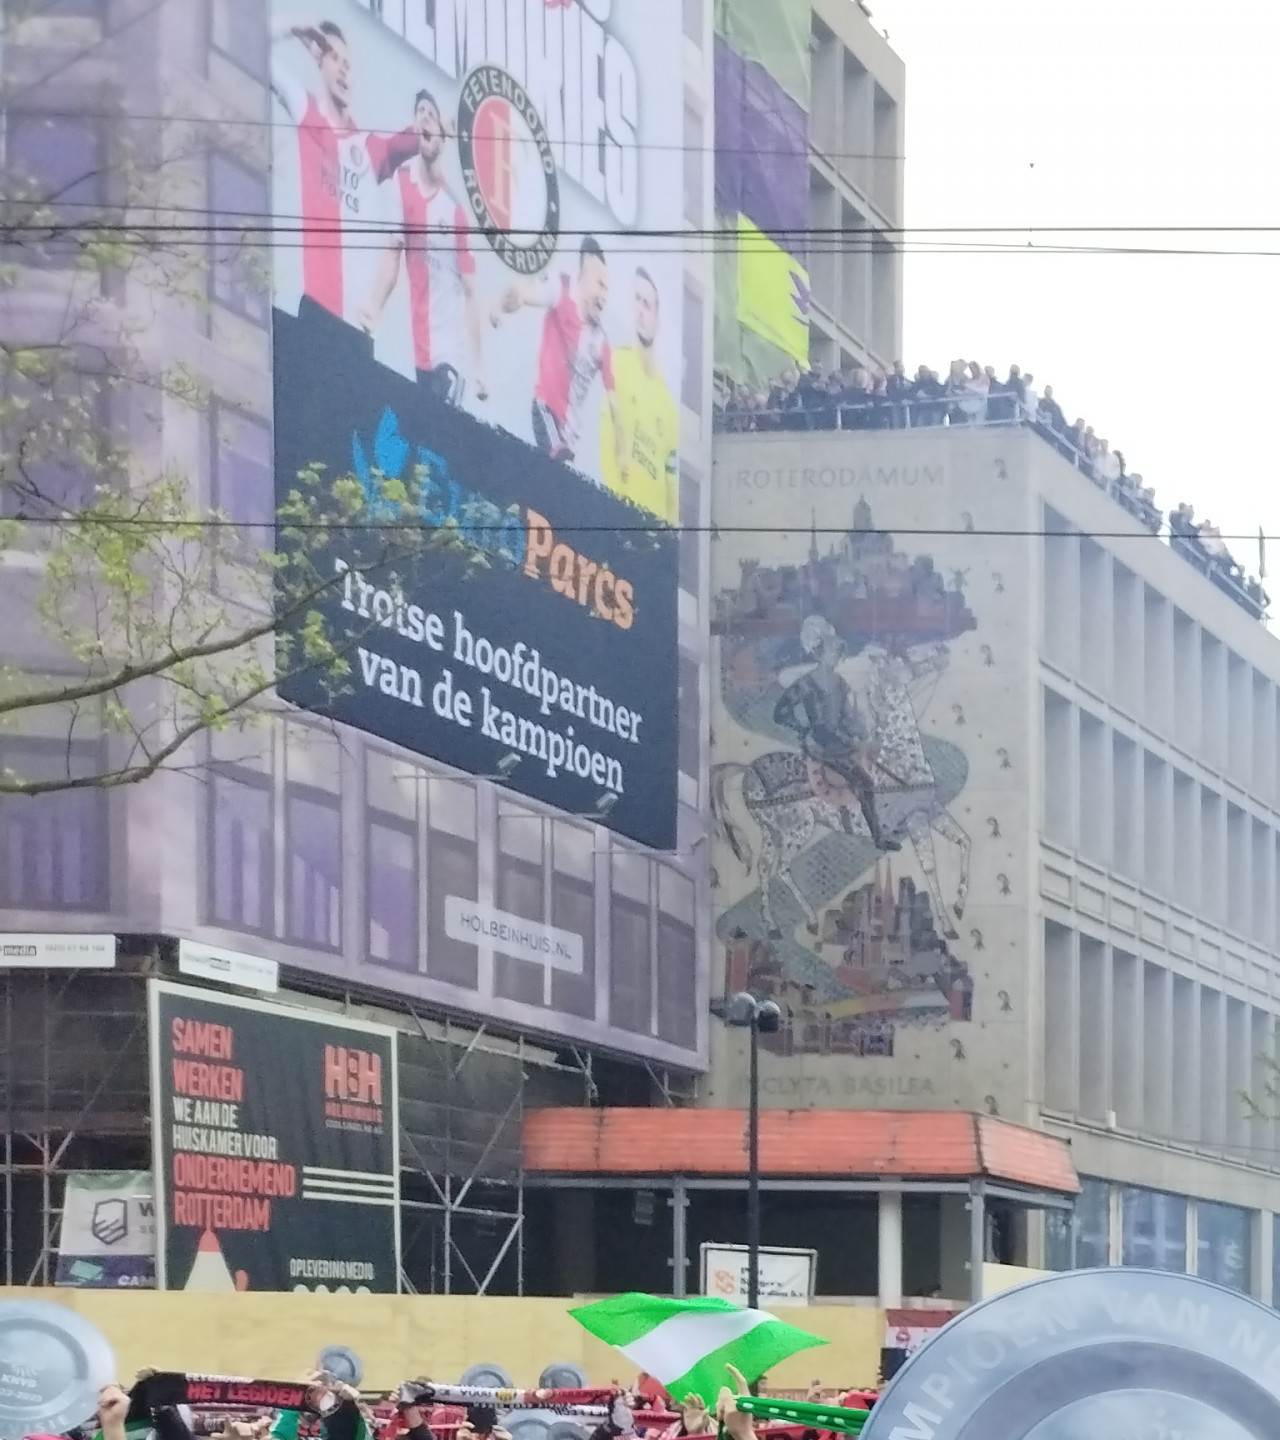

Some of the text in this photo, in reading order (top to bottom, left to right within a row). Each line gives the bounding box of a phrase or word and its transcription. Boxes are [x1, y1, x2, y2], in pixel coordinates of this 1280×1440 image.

[462, 66, 557, 176] FEYENOORD
[736, 466, 945, 490] ROTERODAMUM
[334, 556, 644, 745] Trotse hoofdpartner
[358, 646, 625, 794] van de kampioen
[460, 911, 573, 960] HOLBEINHUIS.NL
[172, 1016, 234, 1061] SAMEN
[172, 1057, 244, 1102] WERKEN
[172, 1096, 239, 1129] WE AAN DE
[172, 1123, 279, 1161] HUISKAMER VOOR
[173, 1152, 296, 1197] ONDERNEMEND
[173, 1190, 271, 1232] ROTTERDAM
[1102, 1297, 1211, 1335] VAN
[187, 1383, 222, 1400] HET
